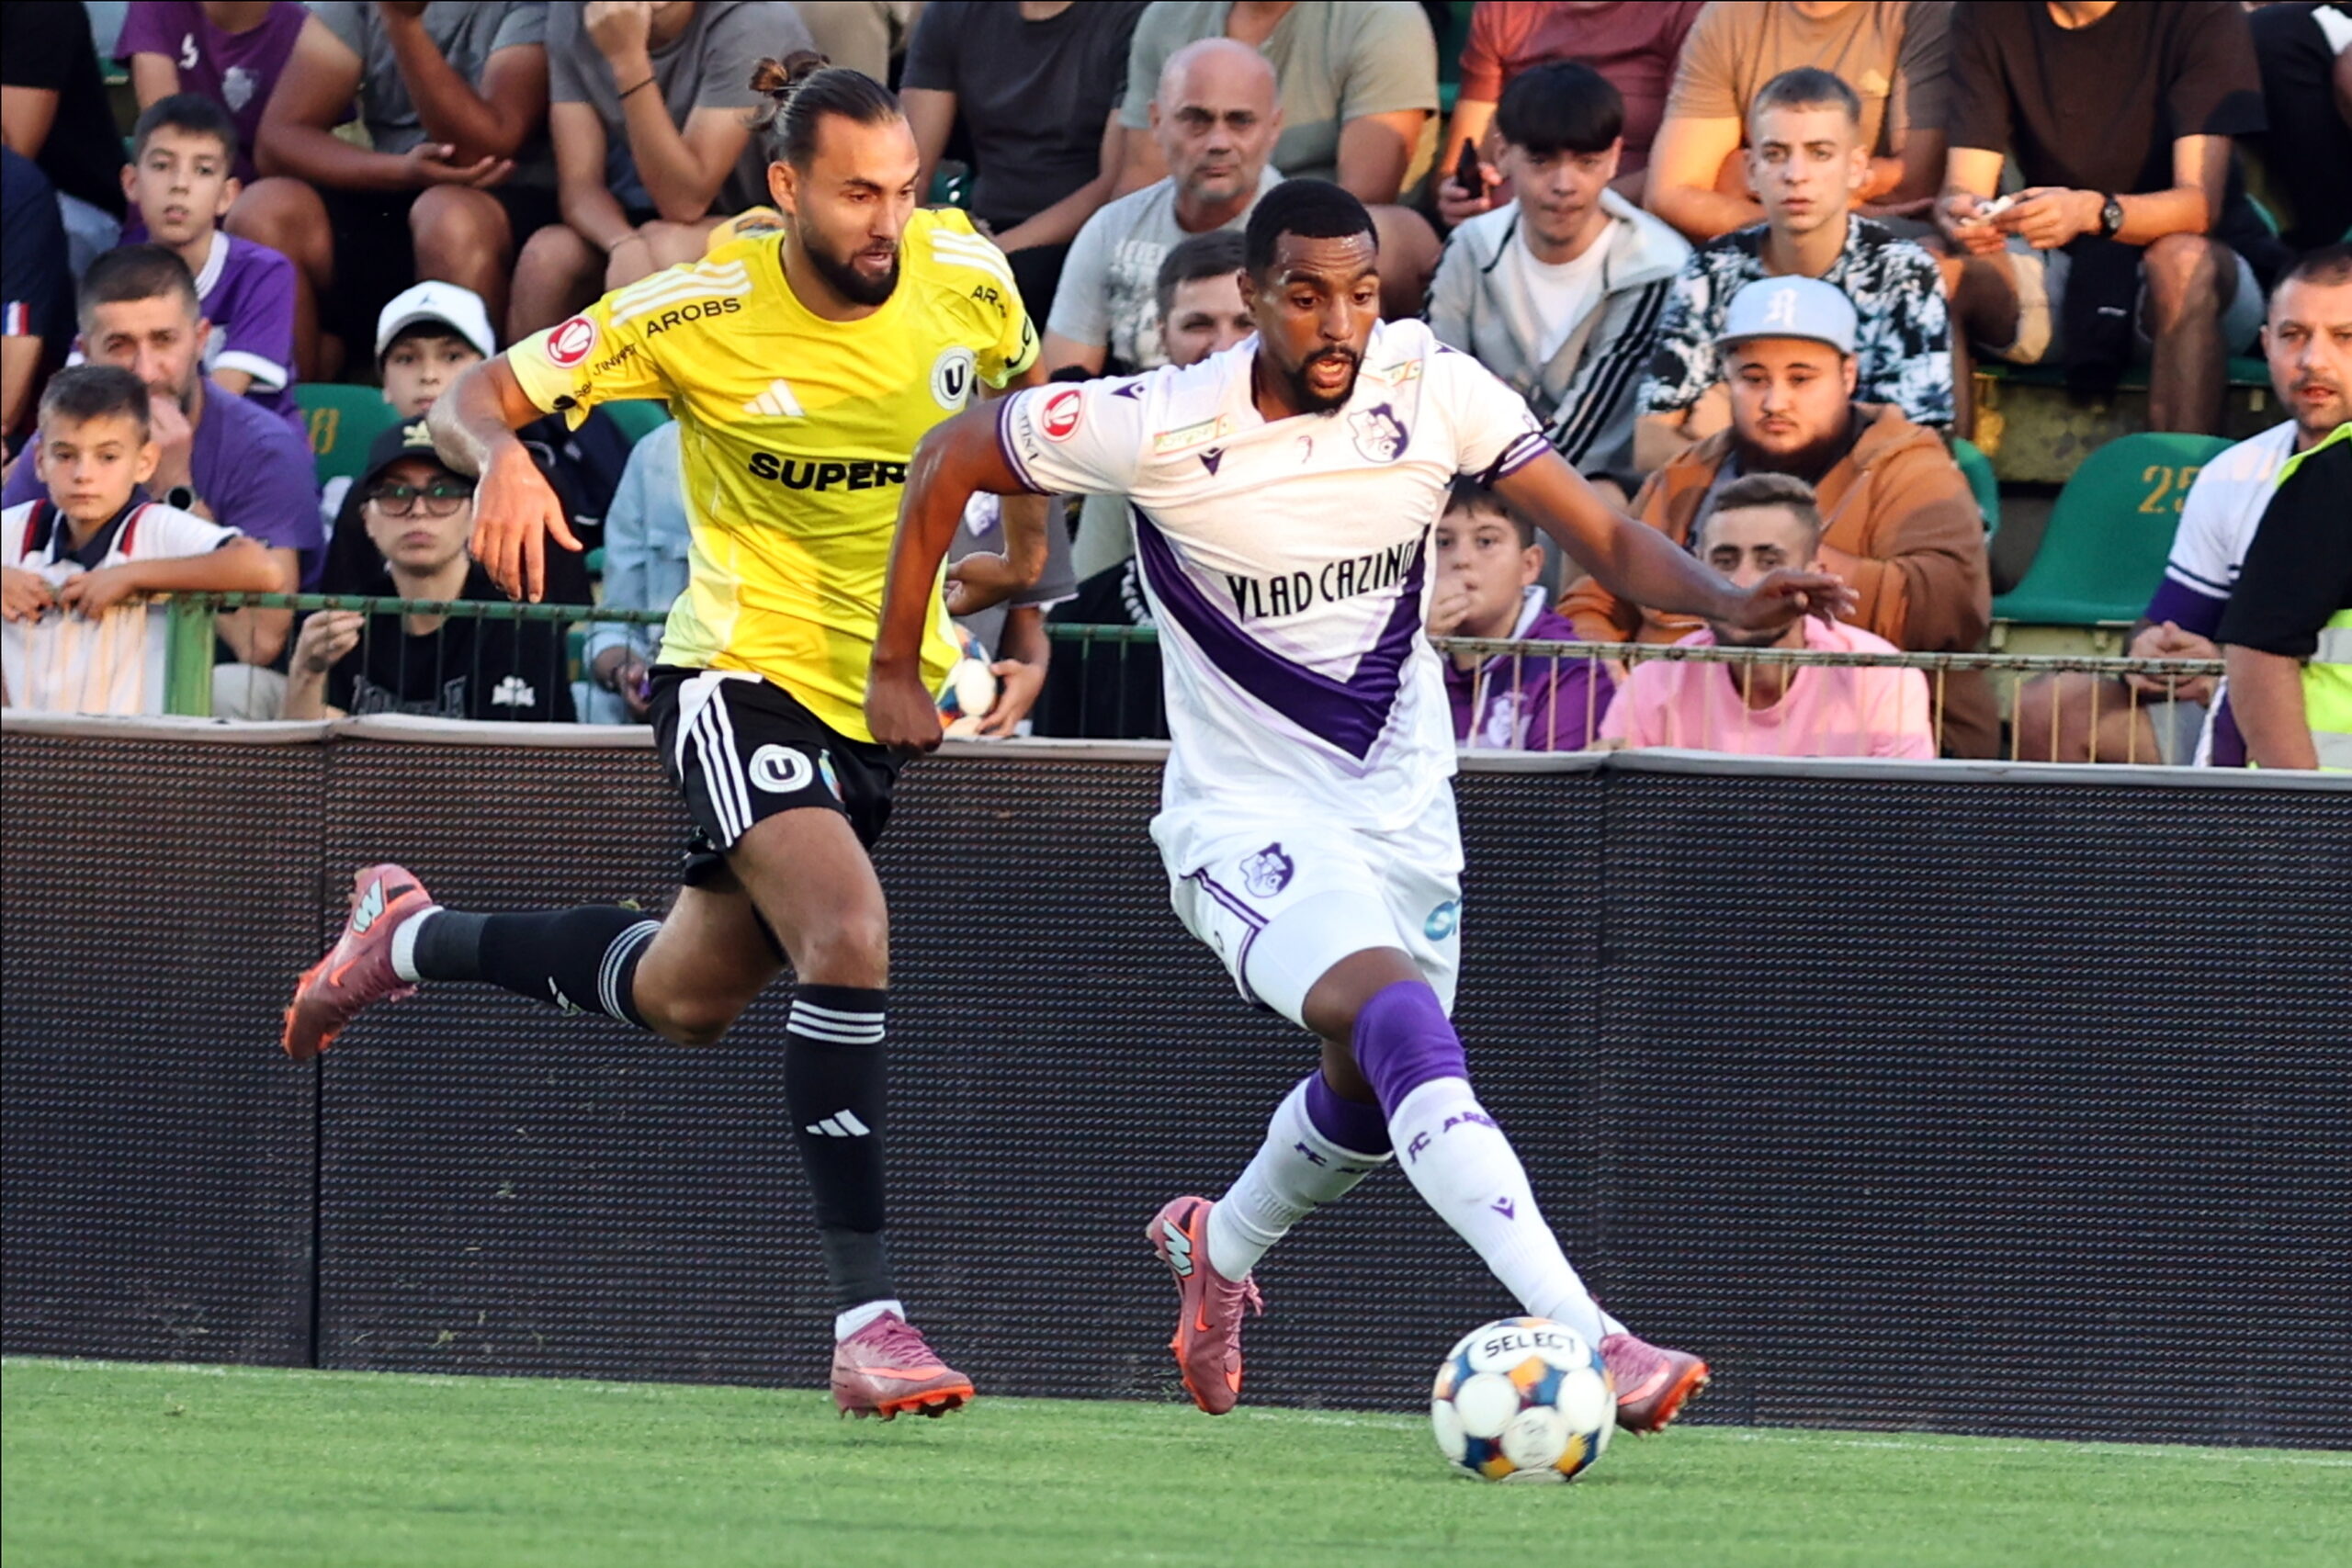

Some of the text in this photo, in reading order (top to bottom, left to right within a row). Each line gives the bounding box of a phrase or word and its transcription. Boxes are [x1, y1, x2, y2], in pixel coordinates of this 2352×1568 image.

[647, 298, 741, 338] AROBS
[944, 364, 965, 396] U
[749, 452, 907, 491] SUPER
[1227, 570, 1312, 626] VLAD
[765, 758, 796, 780] U
[1485, 1333, 1576, 1359] SELECT
